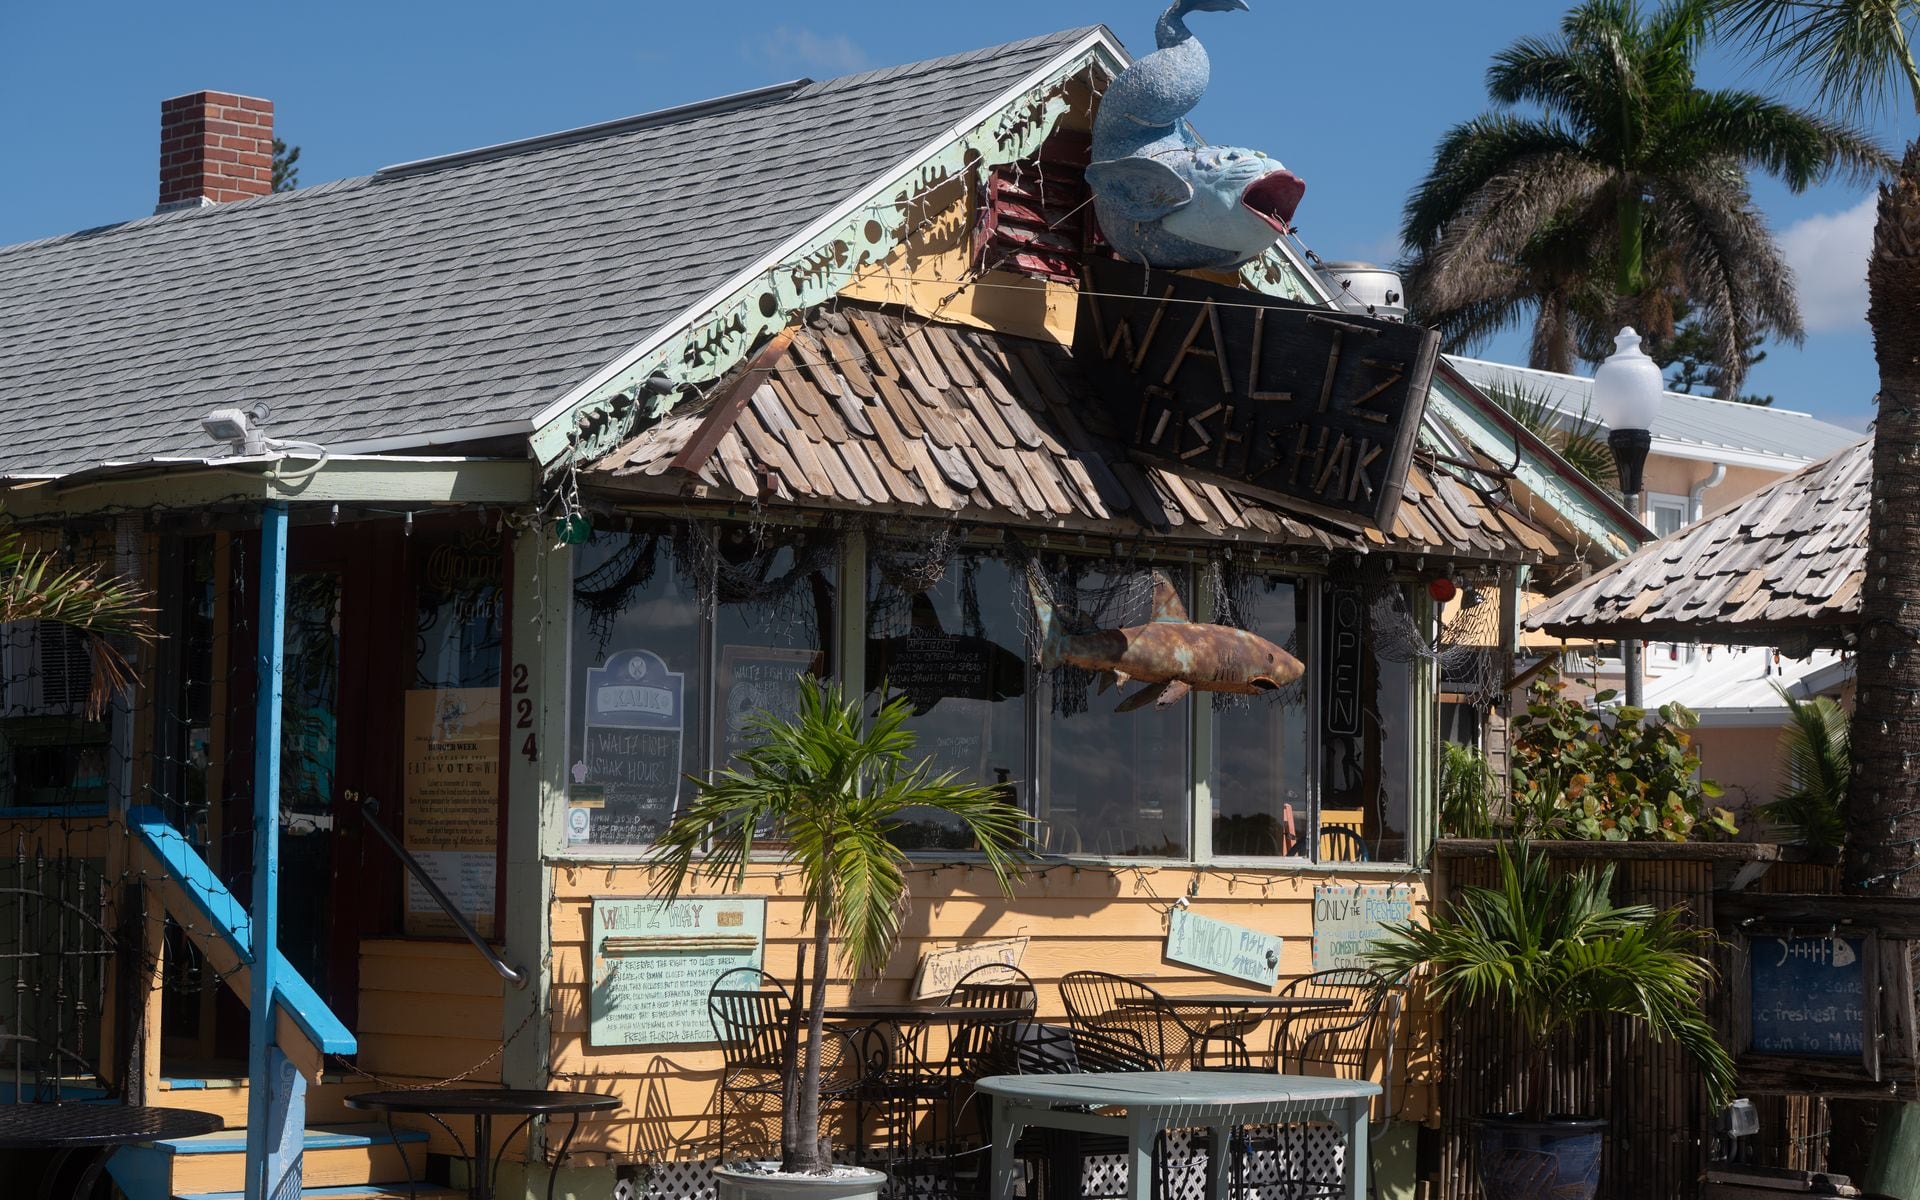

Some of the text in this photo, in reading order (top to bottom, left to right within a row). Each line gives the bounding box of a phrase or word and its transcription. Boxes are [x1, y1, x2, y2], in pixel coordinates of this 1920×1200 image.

[1333, 596, 1358, 727] OPEN
[512, 663, 538, 767] 224
[456, 743, 478, 751] WEEK
[643, 734, 669, 757] FISH
[408, 761, 497, 775] EAT VOTE WI
[595, 757, 666, 784] SHAK HOURS
[667, 903, 704, 928] WAY
[1316, 898, 1409, 923] ONLY THE FRESHEST
[1240, 931, 1267, 955] FISH
[1330, 940, 1362, 957] DOMESTIC
[625, 960, 655, 971] RESERVES
[656, 960, 667, 968] THE
[669, 959, 686, 968] RIGHT
[689, 958, 698, 966] TO
[1232, 953, 1264, 979] SPREAD
[1825, 981, 1863, 994] some
[1773, 1000, 1837, 1023] freshest
[623, 1029, 713, 1043] FRESH FLORIDA SEAFOOD
[1797, 1032, 1820, 1050] to
